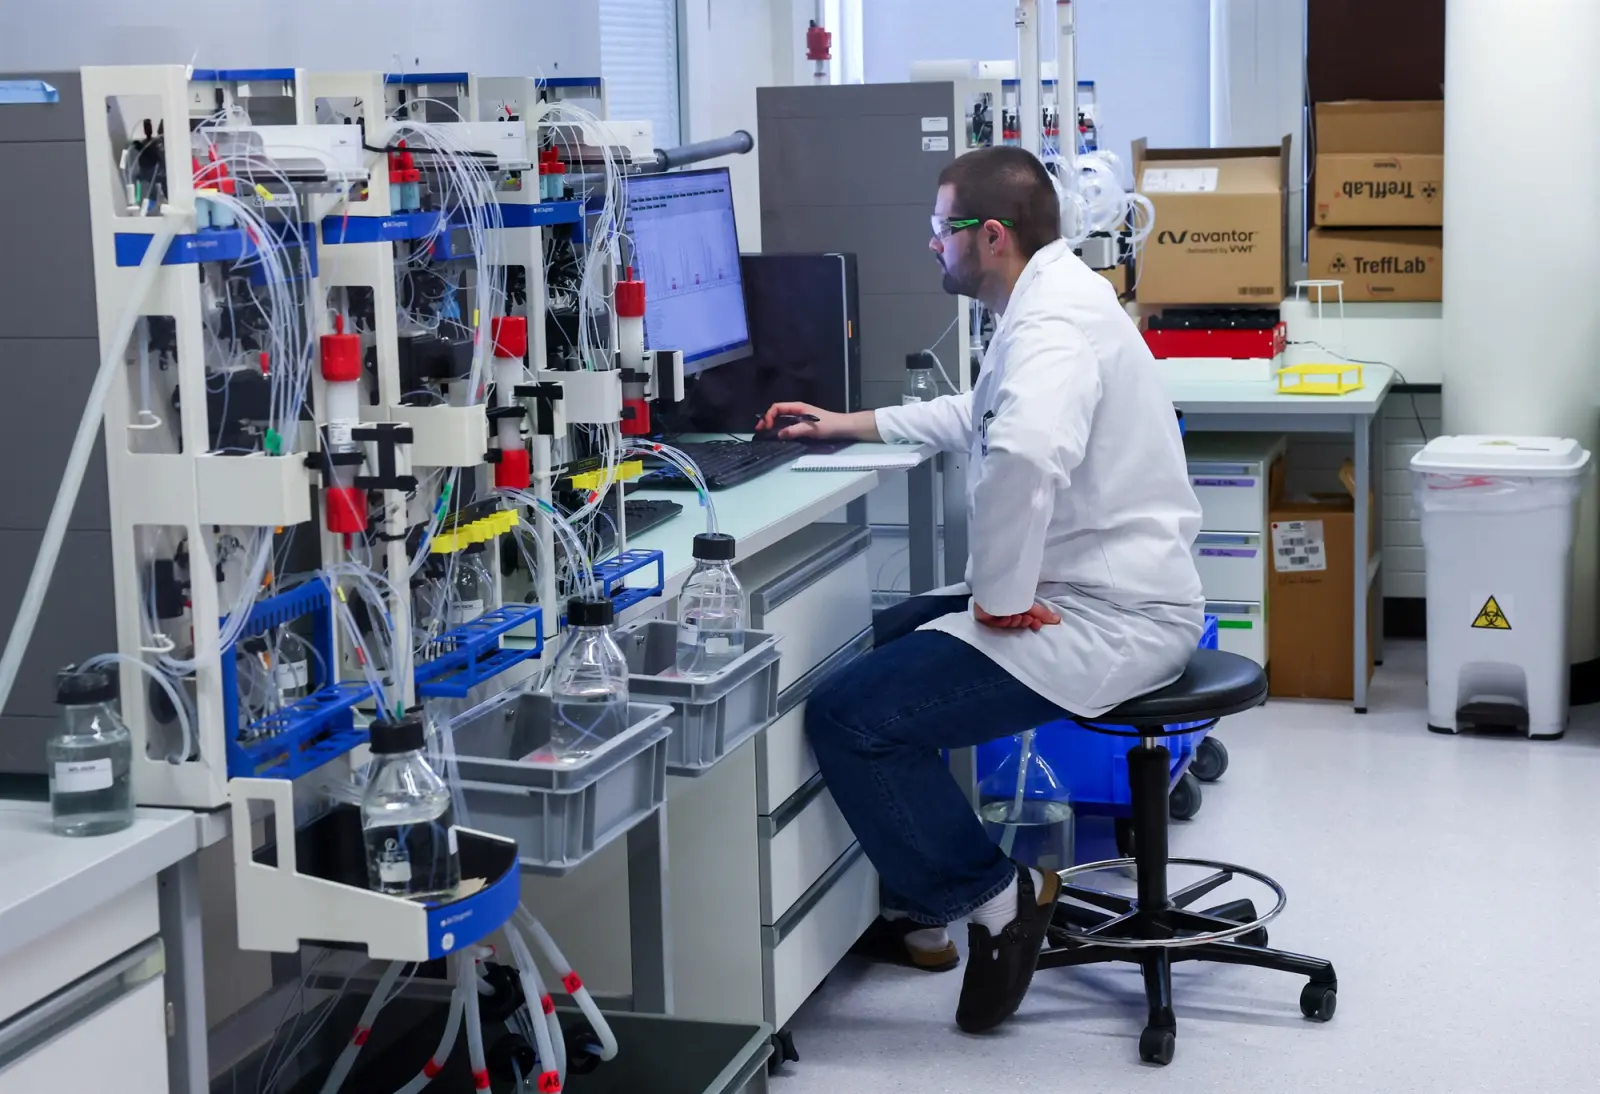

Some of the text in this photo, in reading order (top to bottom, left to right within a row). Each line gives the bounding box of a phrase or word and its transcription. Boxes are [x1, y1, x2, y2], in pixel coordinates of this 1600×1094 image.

[1342, 180, 1415, 199] TreffLab
[1190, 230, 1254, 243] avantor
[1353, 256, 1426, 274] TreffLab
